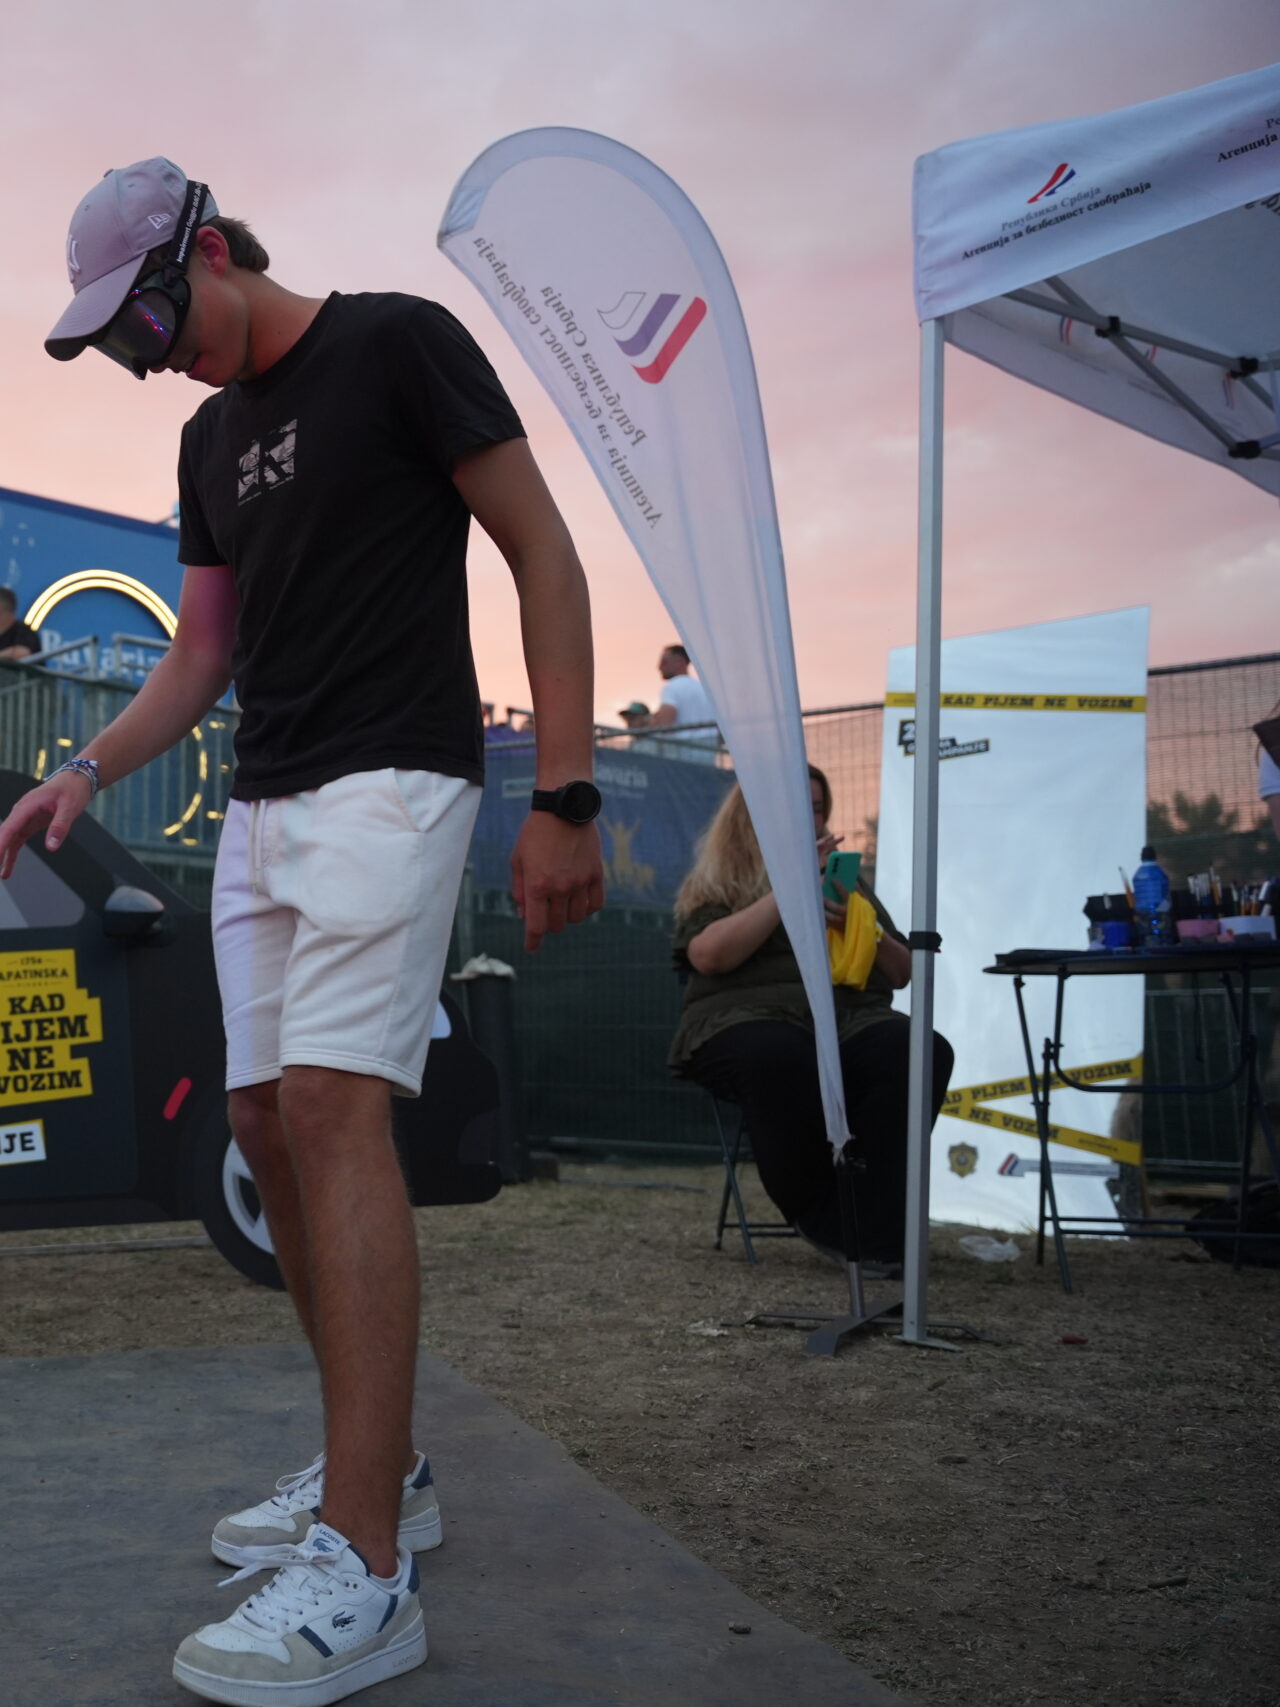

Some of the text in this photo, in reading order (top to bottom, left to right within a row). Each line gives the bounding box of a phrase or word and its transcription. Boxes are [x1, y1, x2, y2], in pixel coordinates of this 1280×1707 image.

[1060, 186, 1101, 209] Србија
[1011, 230, 1024, 241] за
[1025, 207, 1084, 234] безбедност
[1087, 181, 1152, 212] саобраћаја
[943, 695, 1134, 709] KAD PIJEM NE VOZIM
[8, 993, 66, 1015] KAD
[7, 1046, 55, 1071] NE
[972, 1080, 1026, 1100] PIJEM
[968, 1108, 992, 1122] NE
[1002, 1115, 1060, 1139] VOZM
